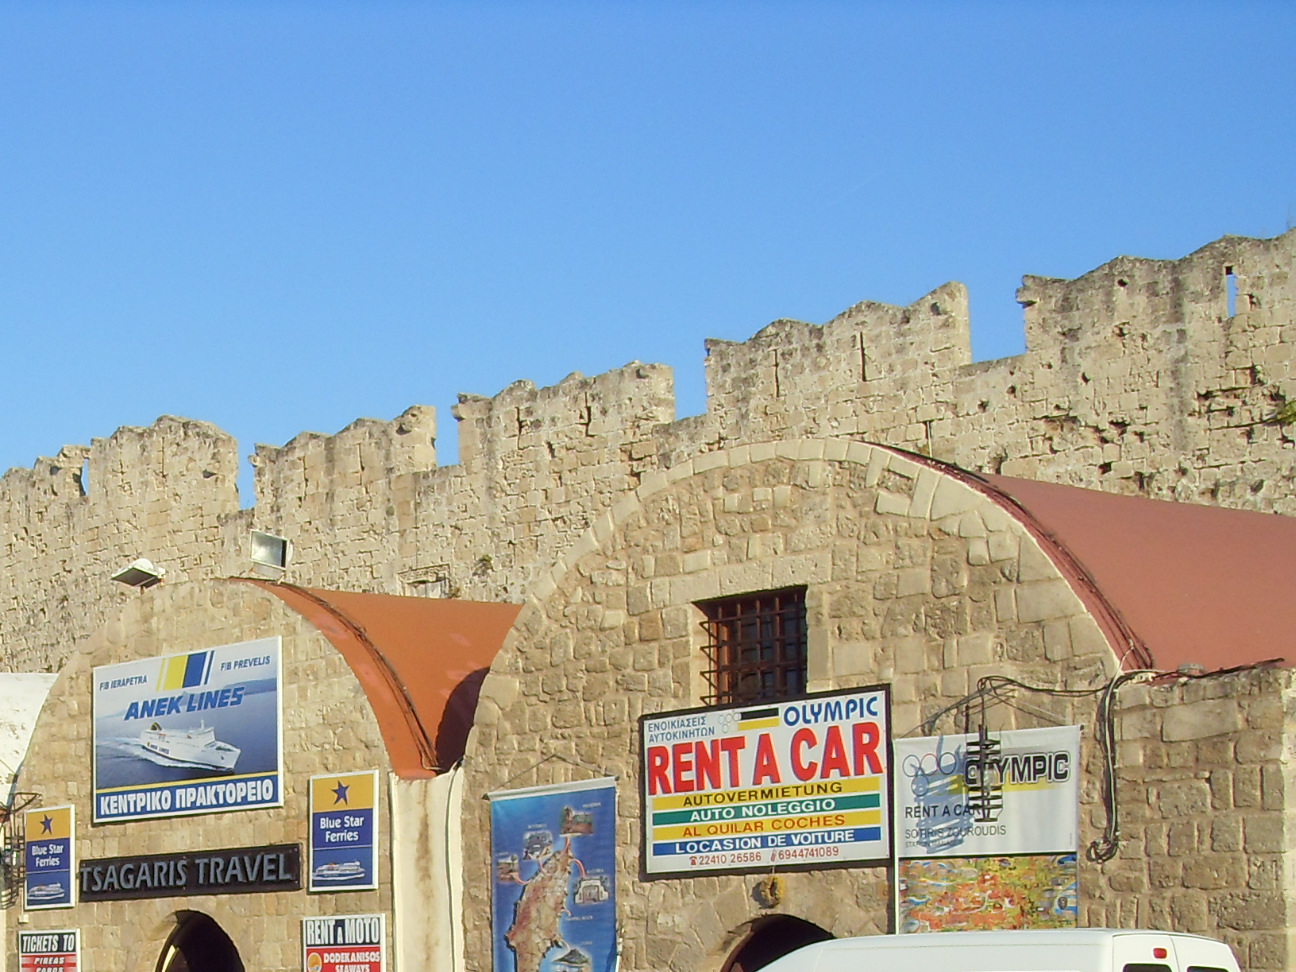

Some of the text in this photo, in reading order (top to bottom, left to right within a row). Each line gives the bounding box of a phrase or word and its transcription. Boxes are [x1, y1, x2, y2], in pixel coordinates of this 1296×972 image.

[233, 655, 271, 669] PREVELIS
[110, 675, 148, 689] IERAPETRA
[124, 687, 245, 721] ANEK LINES
[783, 697, 878, 727] OLYMPIC
[648, 716, 707, 732] ΕΝΟΙΚΙΑΣΕΙΣ
[648, 726, 715, 743] ΑΥΤΟΚΙΝΗΤΩΝ
[648, 721, 884, 796] RENT A CAR
[965, 752, 1070, 786] OYMPIC
[100, 778, 274, 816] ΚΕΝΤΡΙΚΟ ΠΡΑΚΤΟΡΕΙΟ
[683, 781, 843, 807] AUTOVERMIETUNG
[690, 799, 836, 822] AUTO NOLEGGIO
[905, 803, 981, 818] RENT A CAR
[320, 815, 365, 829] Blue Star
[682, 814, 846, 838] AL QUILAR COCHES
[325, 829, 359, 843] Ferries
[675, 830, 855, 854] LOCASION DE VOITURE
[31, 844, 64, 856] Blue Star
[699, 846, 839, 866] 22410 26586 6944741089
[35, 856, 60, 867] Ferries
[80, 853, 293, 892] TSAGARIS TRAVEL
[306, 917, 380, 945] RENT A MOTO
[22, 934, 75, 953] TICKETS TO
[33, 956, 65, 965] PIREAS
[323, 952, 380, 963] DODEKANISOS
